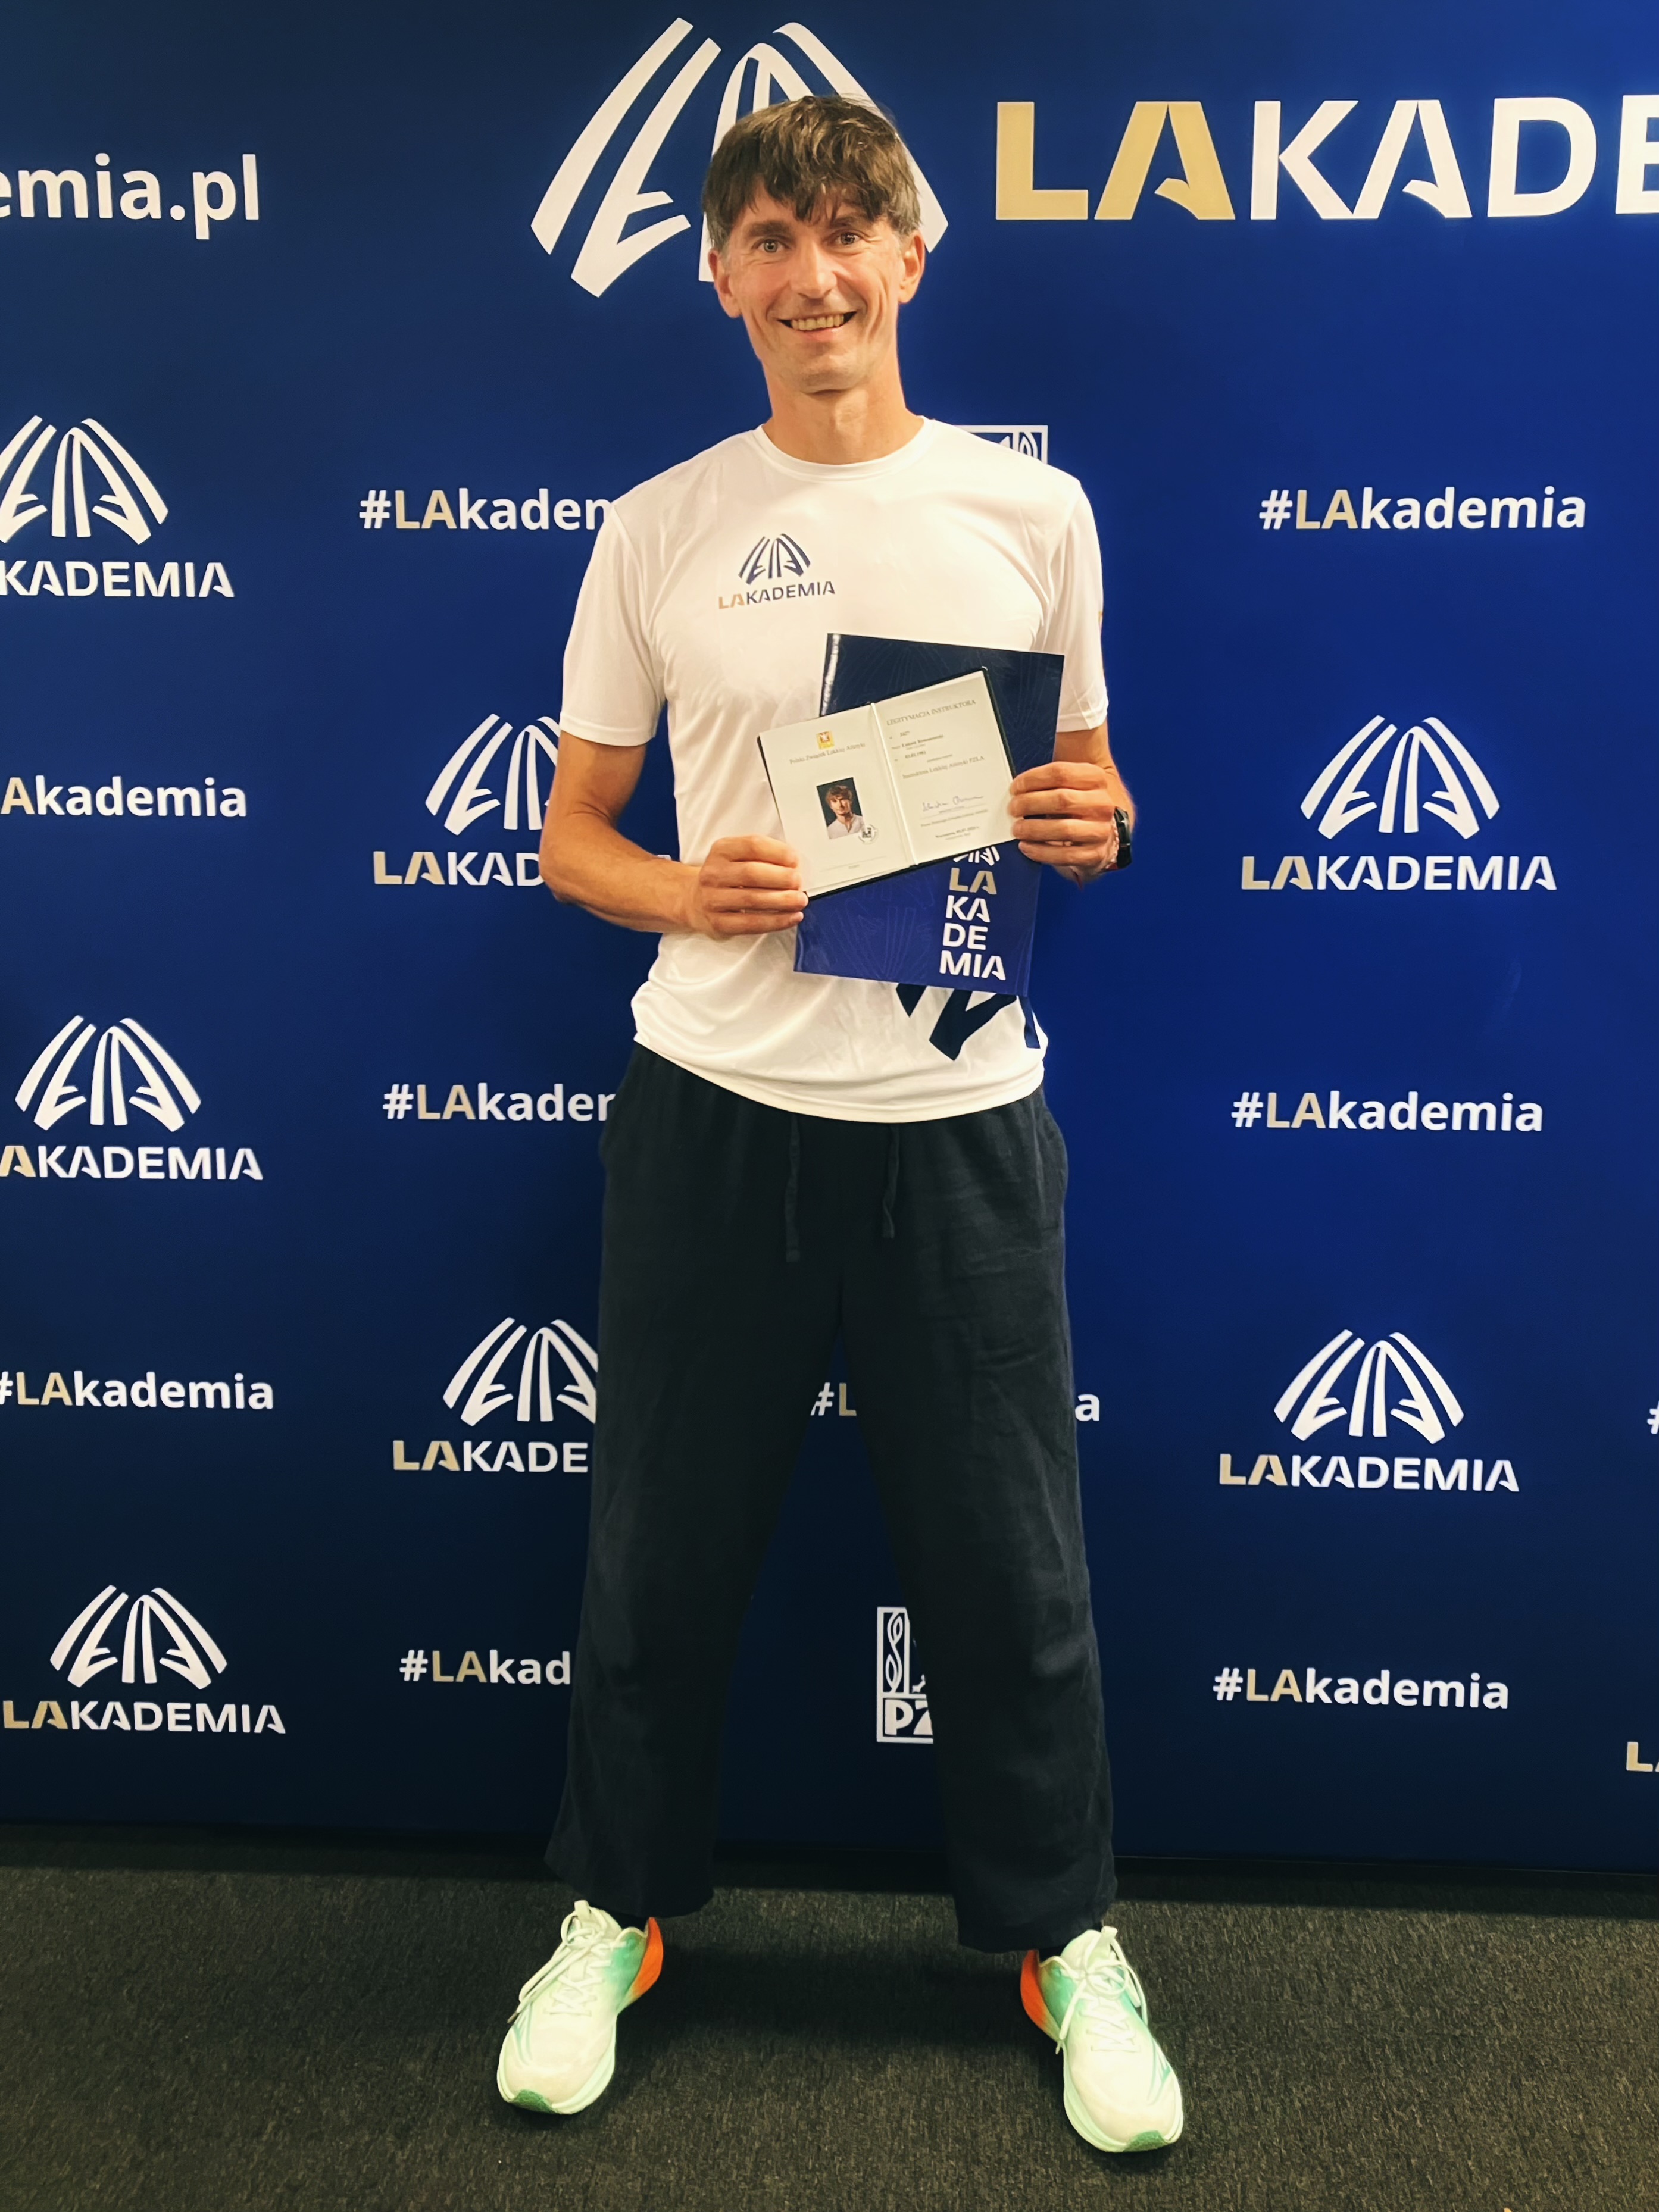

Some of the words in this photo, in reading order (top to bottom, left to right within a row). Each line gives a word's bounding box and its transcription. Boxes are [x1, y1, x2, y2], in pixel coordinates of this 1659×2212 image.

[0, 153, 258, 239] mia.pl
[1260, 486, 1585, 529] #LAkademia
[0, 561, 234, 597] KADEMIA
[718, 581, 835, 609] LAKADEMIA
[930, 700, 976, 714] INSTRUKTORA
[1, 775, 246, 816] Akademia
[949, 869, 996, 894] LA
[1242, 856, 1557, 890] LAKADEMIA
[946, 895, 990, 922] KA
[942, 923, 988, 950] DE
[939, 950, 1005, 980] MIA
[1232, 1091, 1542, 1131] #LAkademia
[0, 1146, 263, 1180] AKADEMIA
[393, 1441, 588, 1472] LAKADE
[1220, 1454, 1519, 1491] LAKADEMIA
[400, 1650, 570, 1685] #LAkad
[1213, 1668, 1508, 1709] #LAkademia
[4, 1701, 285, 1733] LAKADEMIA
